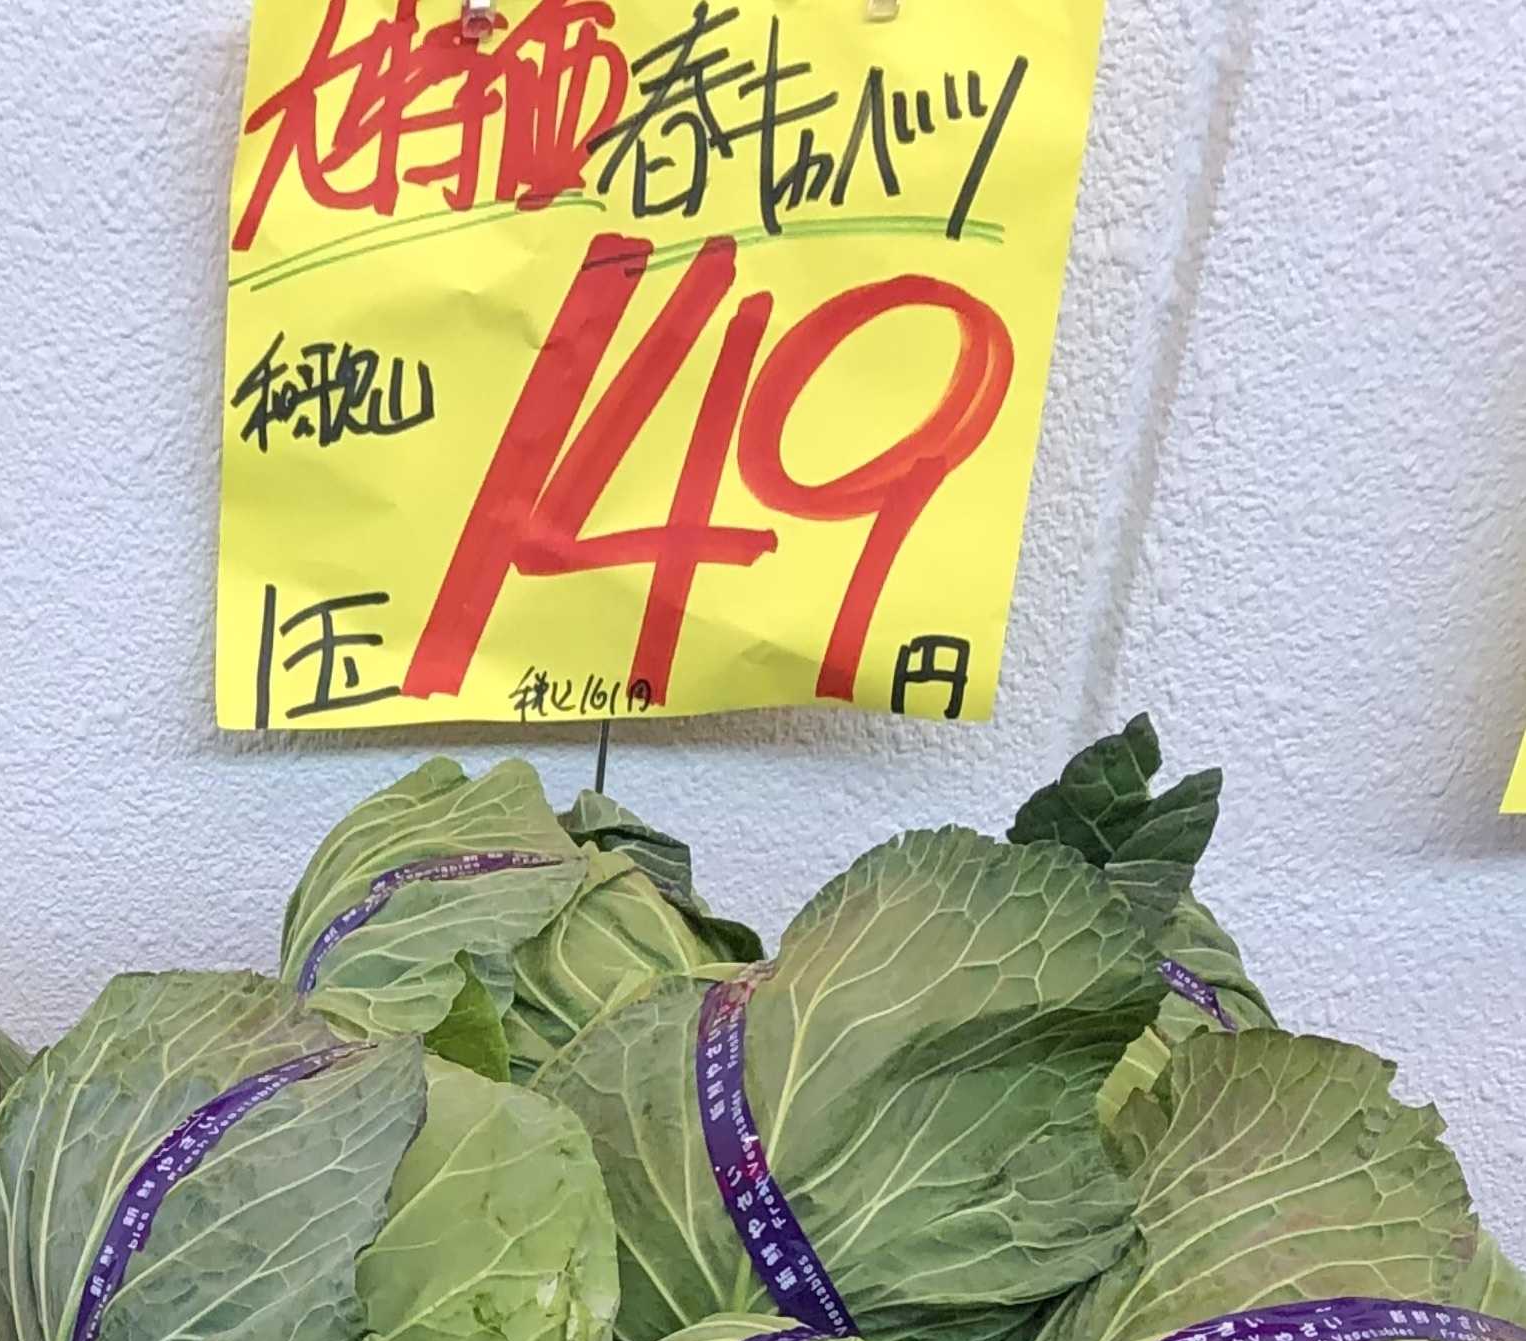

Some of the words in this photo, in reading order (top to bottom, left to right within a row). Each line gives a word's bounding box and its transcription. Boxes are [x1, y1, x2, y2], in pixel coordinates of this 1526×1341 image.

[586, 0, 1028, 238] 春キャベツ
[233, 332, 433, 452] 和歌山
[402, 233, 1014, 703] 149
[891, 635, 969, 719] 円
